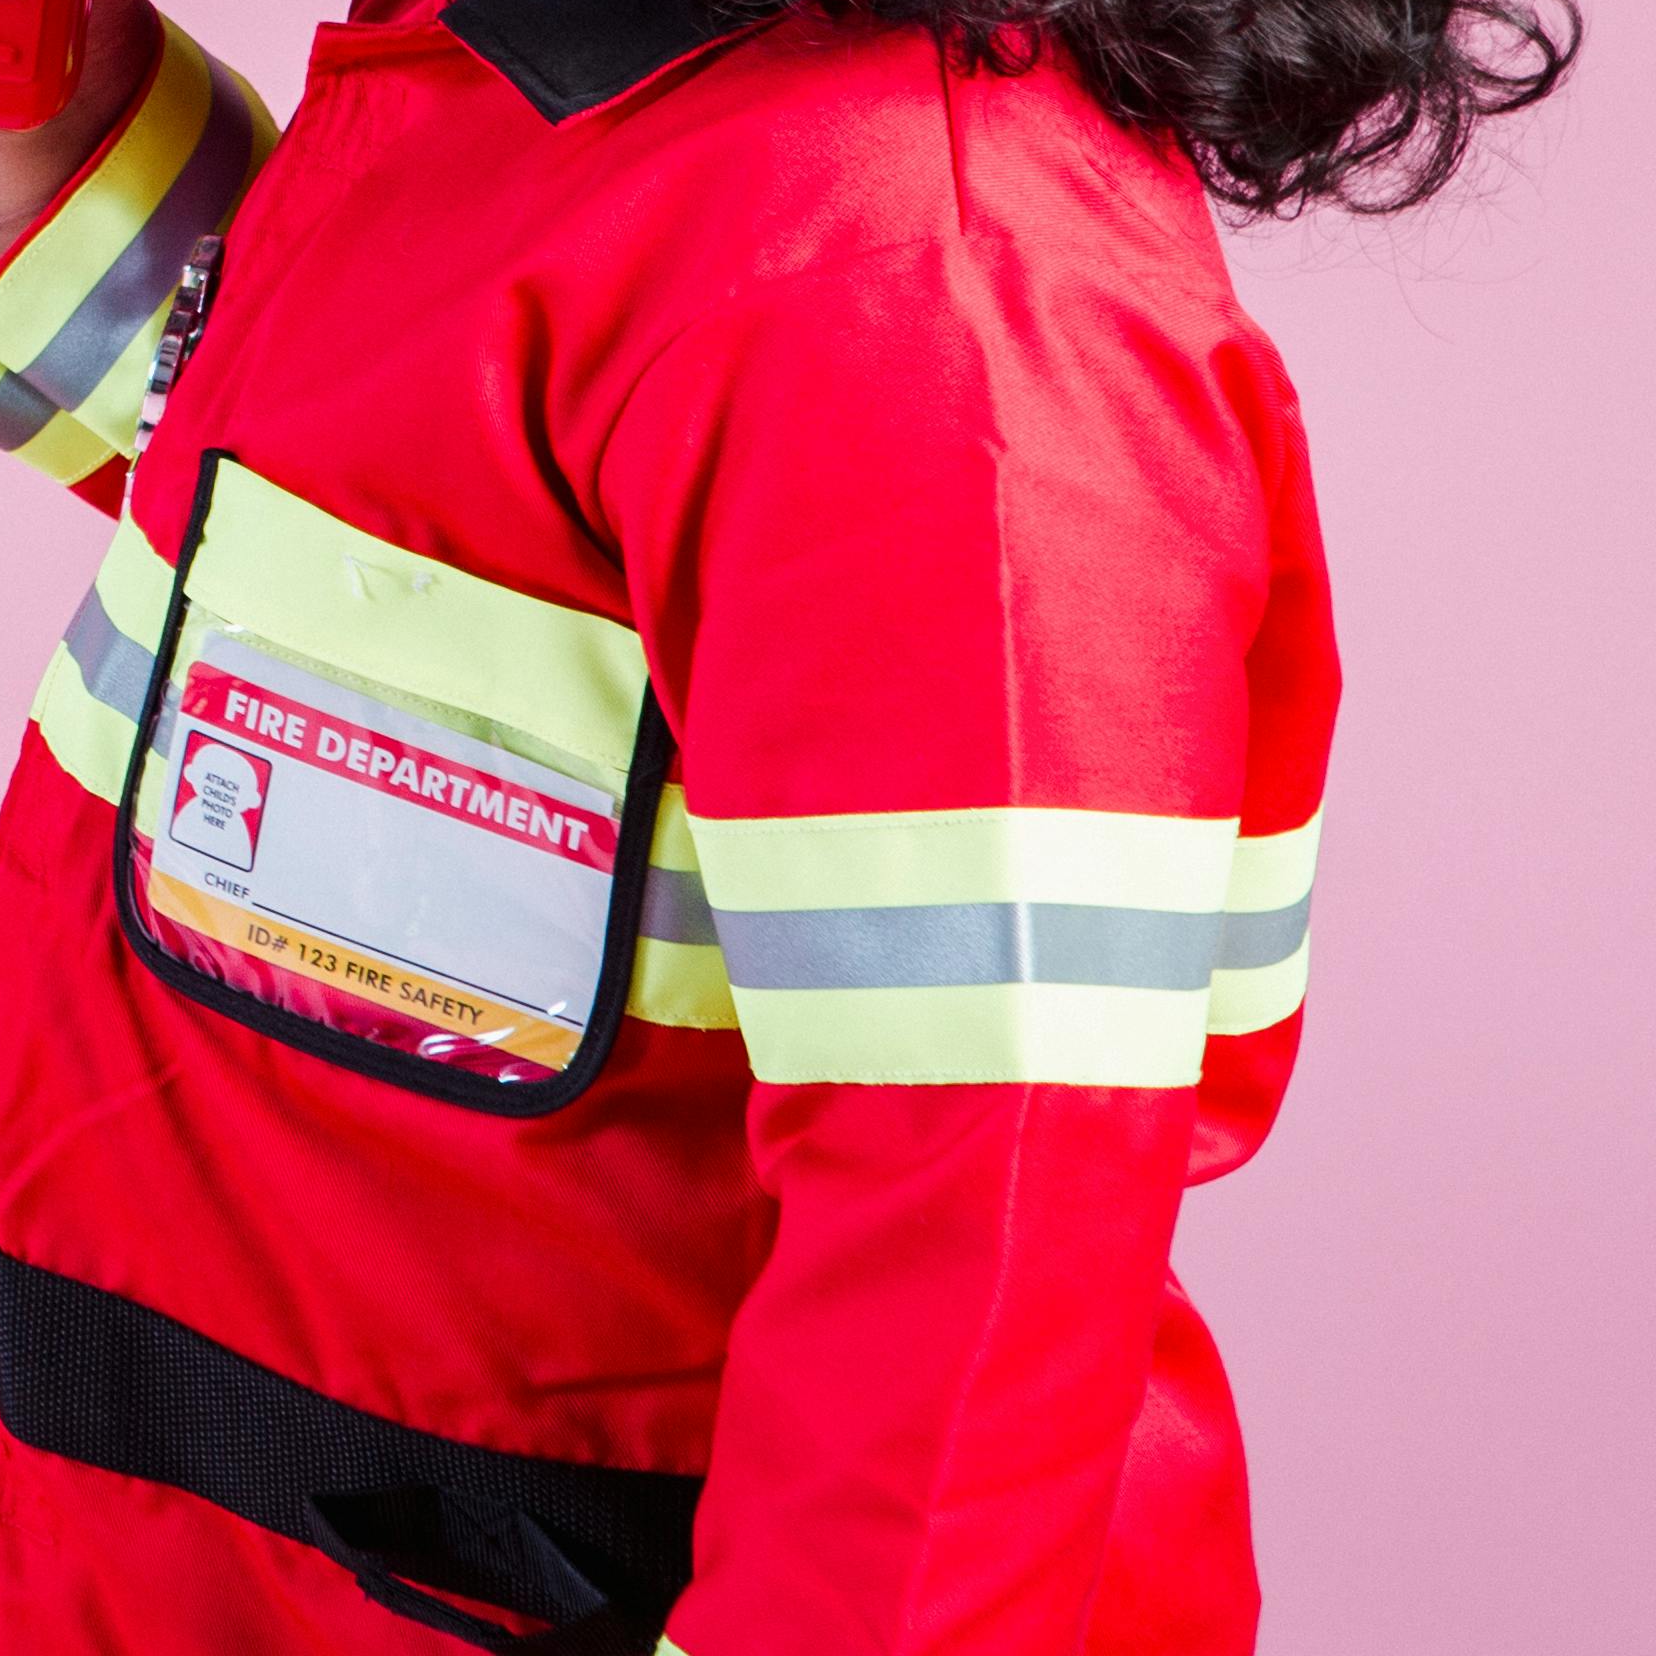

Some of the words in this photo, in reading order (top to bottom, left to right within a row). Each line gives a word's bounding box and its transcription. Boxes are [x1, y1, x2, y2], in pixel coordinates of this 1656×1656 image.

[223, 689, 307, 749] FIRE
[315, 726, 589, 851] DEPARTMENT
[205, 772, 240, 793] ATTACH
[202, 798, 233, 819] PHOTO
[203, 813, 226, 831] HERE
[203, 872, 250, 899] CHIEF
[247, 924, 289, 953] ID#
[298, 944, 338, 973] 123
[345, 961, 393, 994] FIRE
[399, 982, 484, 1026] SAFETY
